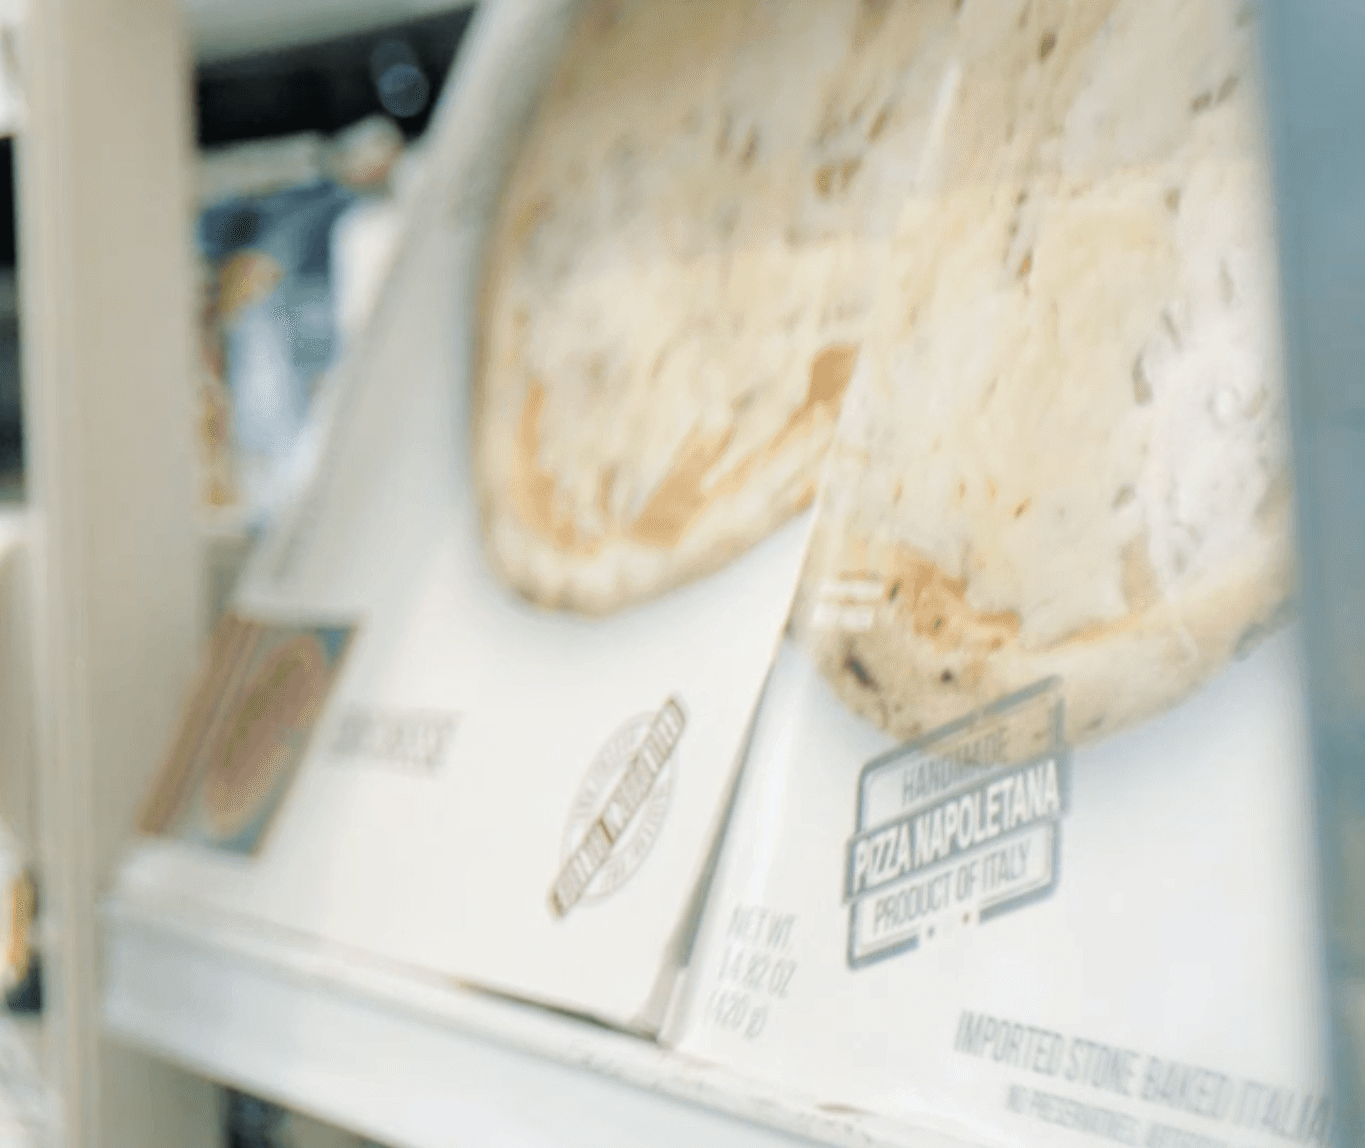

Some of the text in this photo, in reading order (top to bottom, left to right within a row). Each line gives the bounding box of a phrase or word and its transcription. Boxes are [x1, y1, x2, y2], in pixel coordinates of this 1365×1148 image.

[853, 758, 1062, 896] PIZZA NAPOLETANA
[873, 836, 1032, 936] PRODUCT OF ITALY
[953, 1009, 1064, 1077] IMPORTED
[1064, 1035, 1140, 1098] STONE
[1140, 1055, 1233, 1121] BAKED
